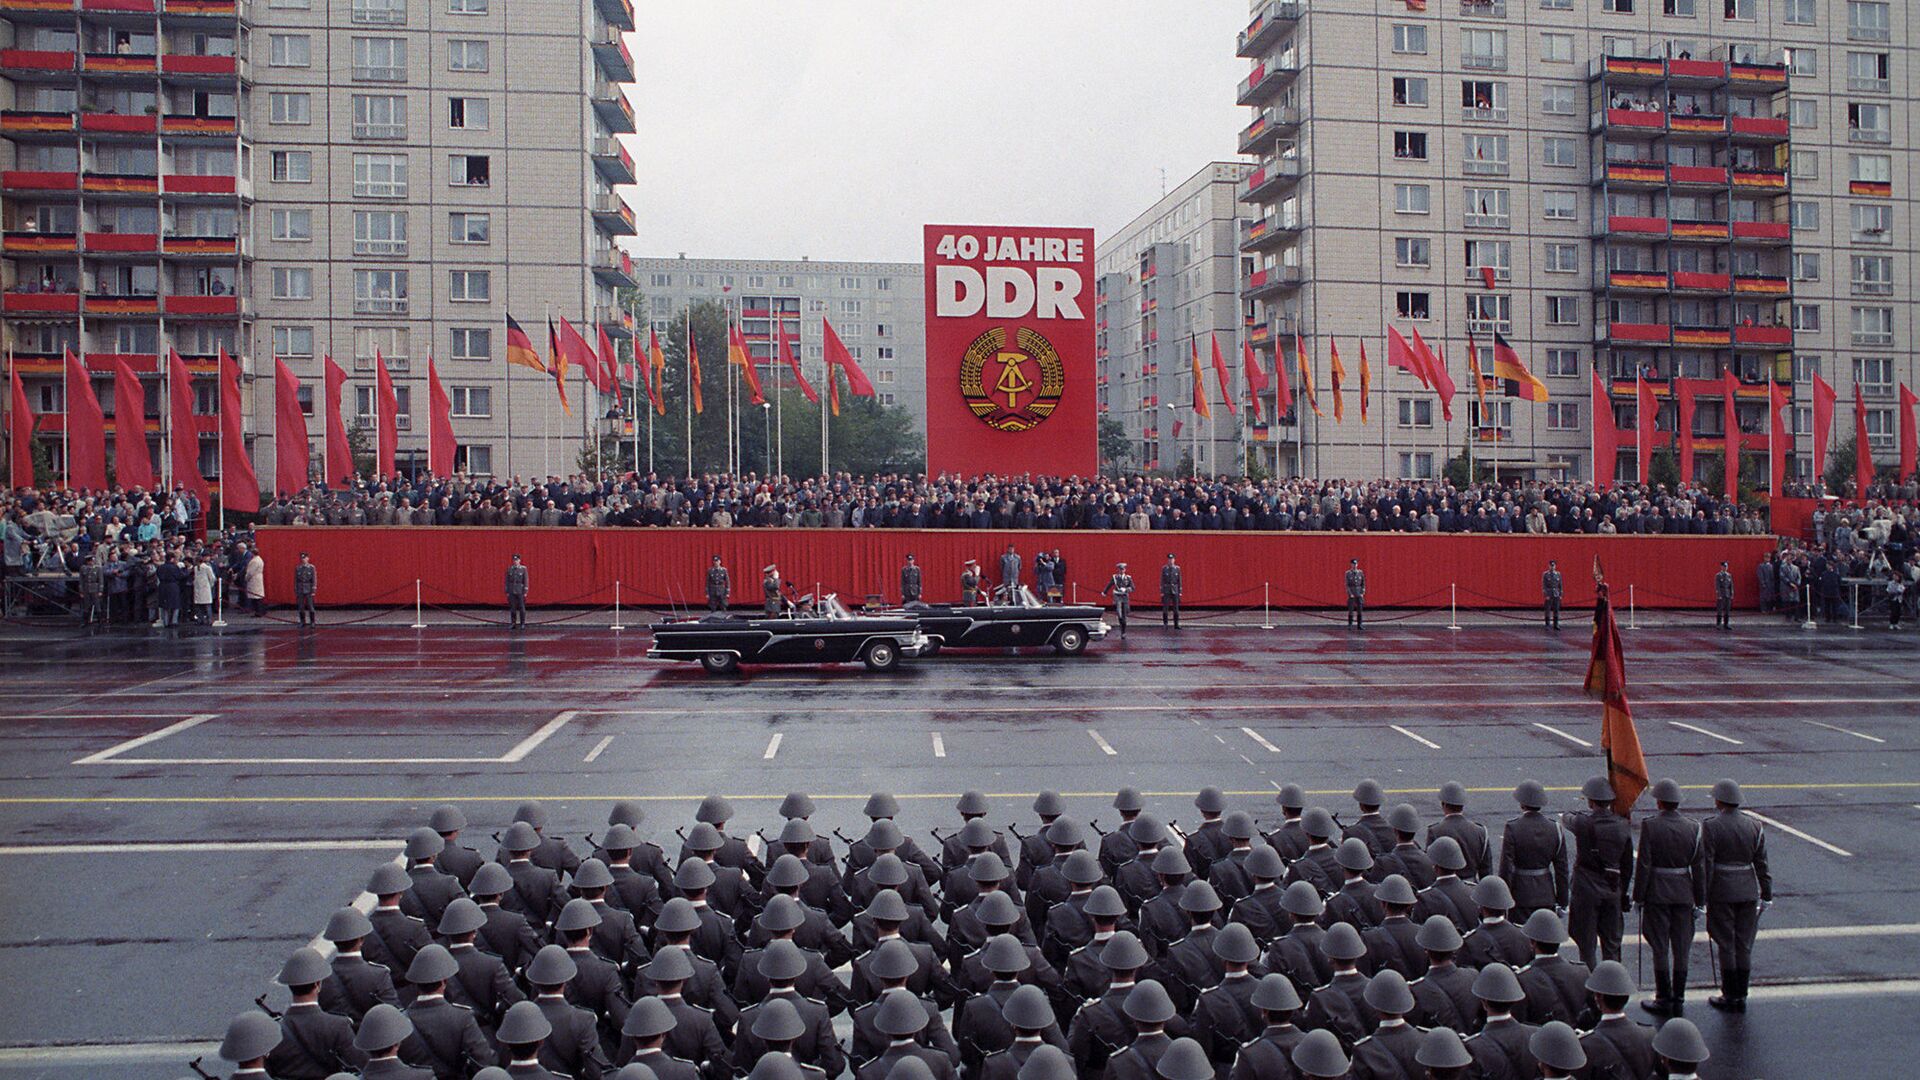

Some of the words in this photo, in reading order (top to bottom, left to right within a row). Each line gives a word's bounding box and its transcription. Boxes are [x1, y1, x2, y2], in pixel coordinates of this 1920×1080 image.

[936, 234, 980, 260] 40
[984, 236, 1084, 262] JAHRE
[936, 265, 1085, 319] DDR
